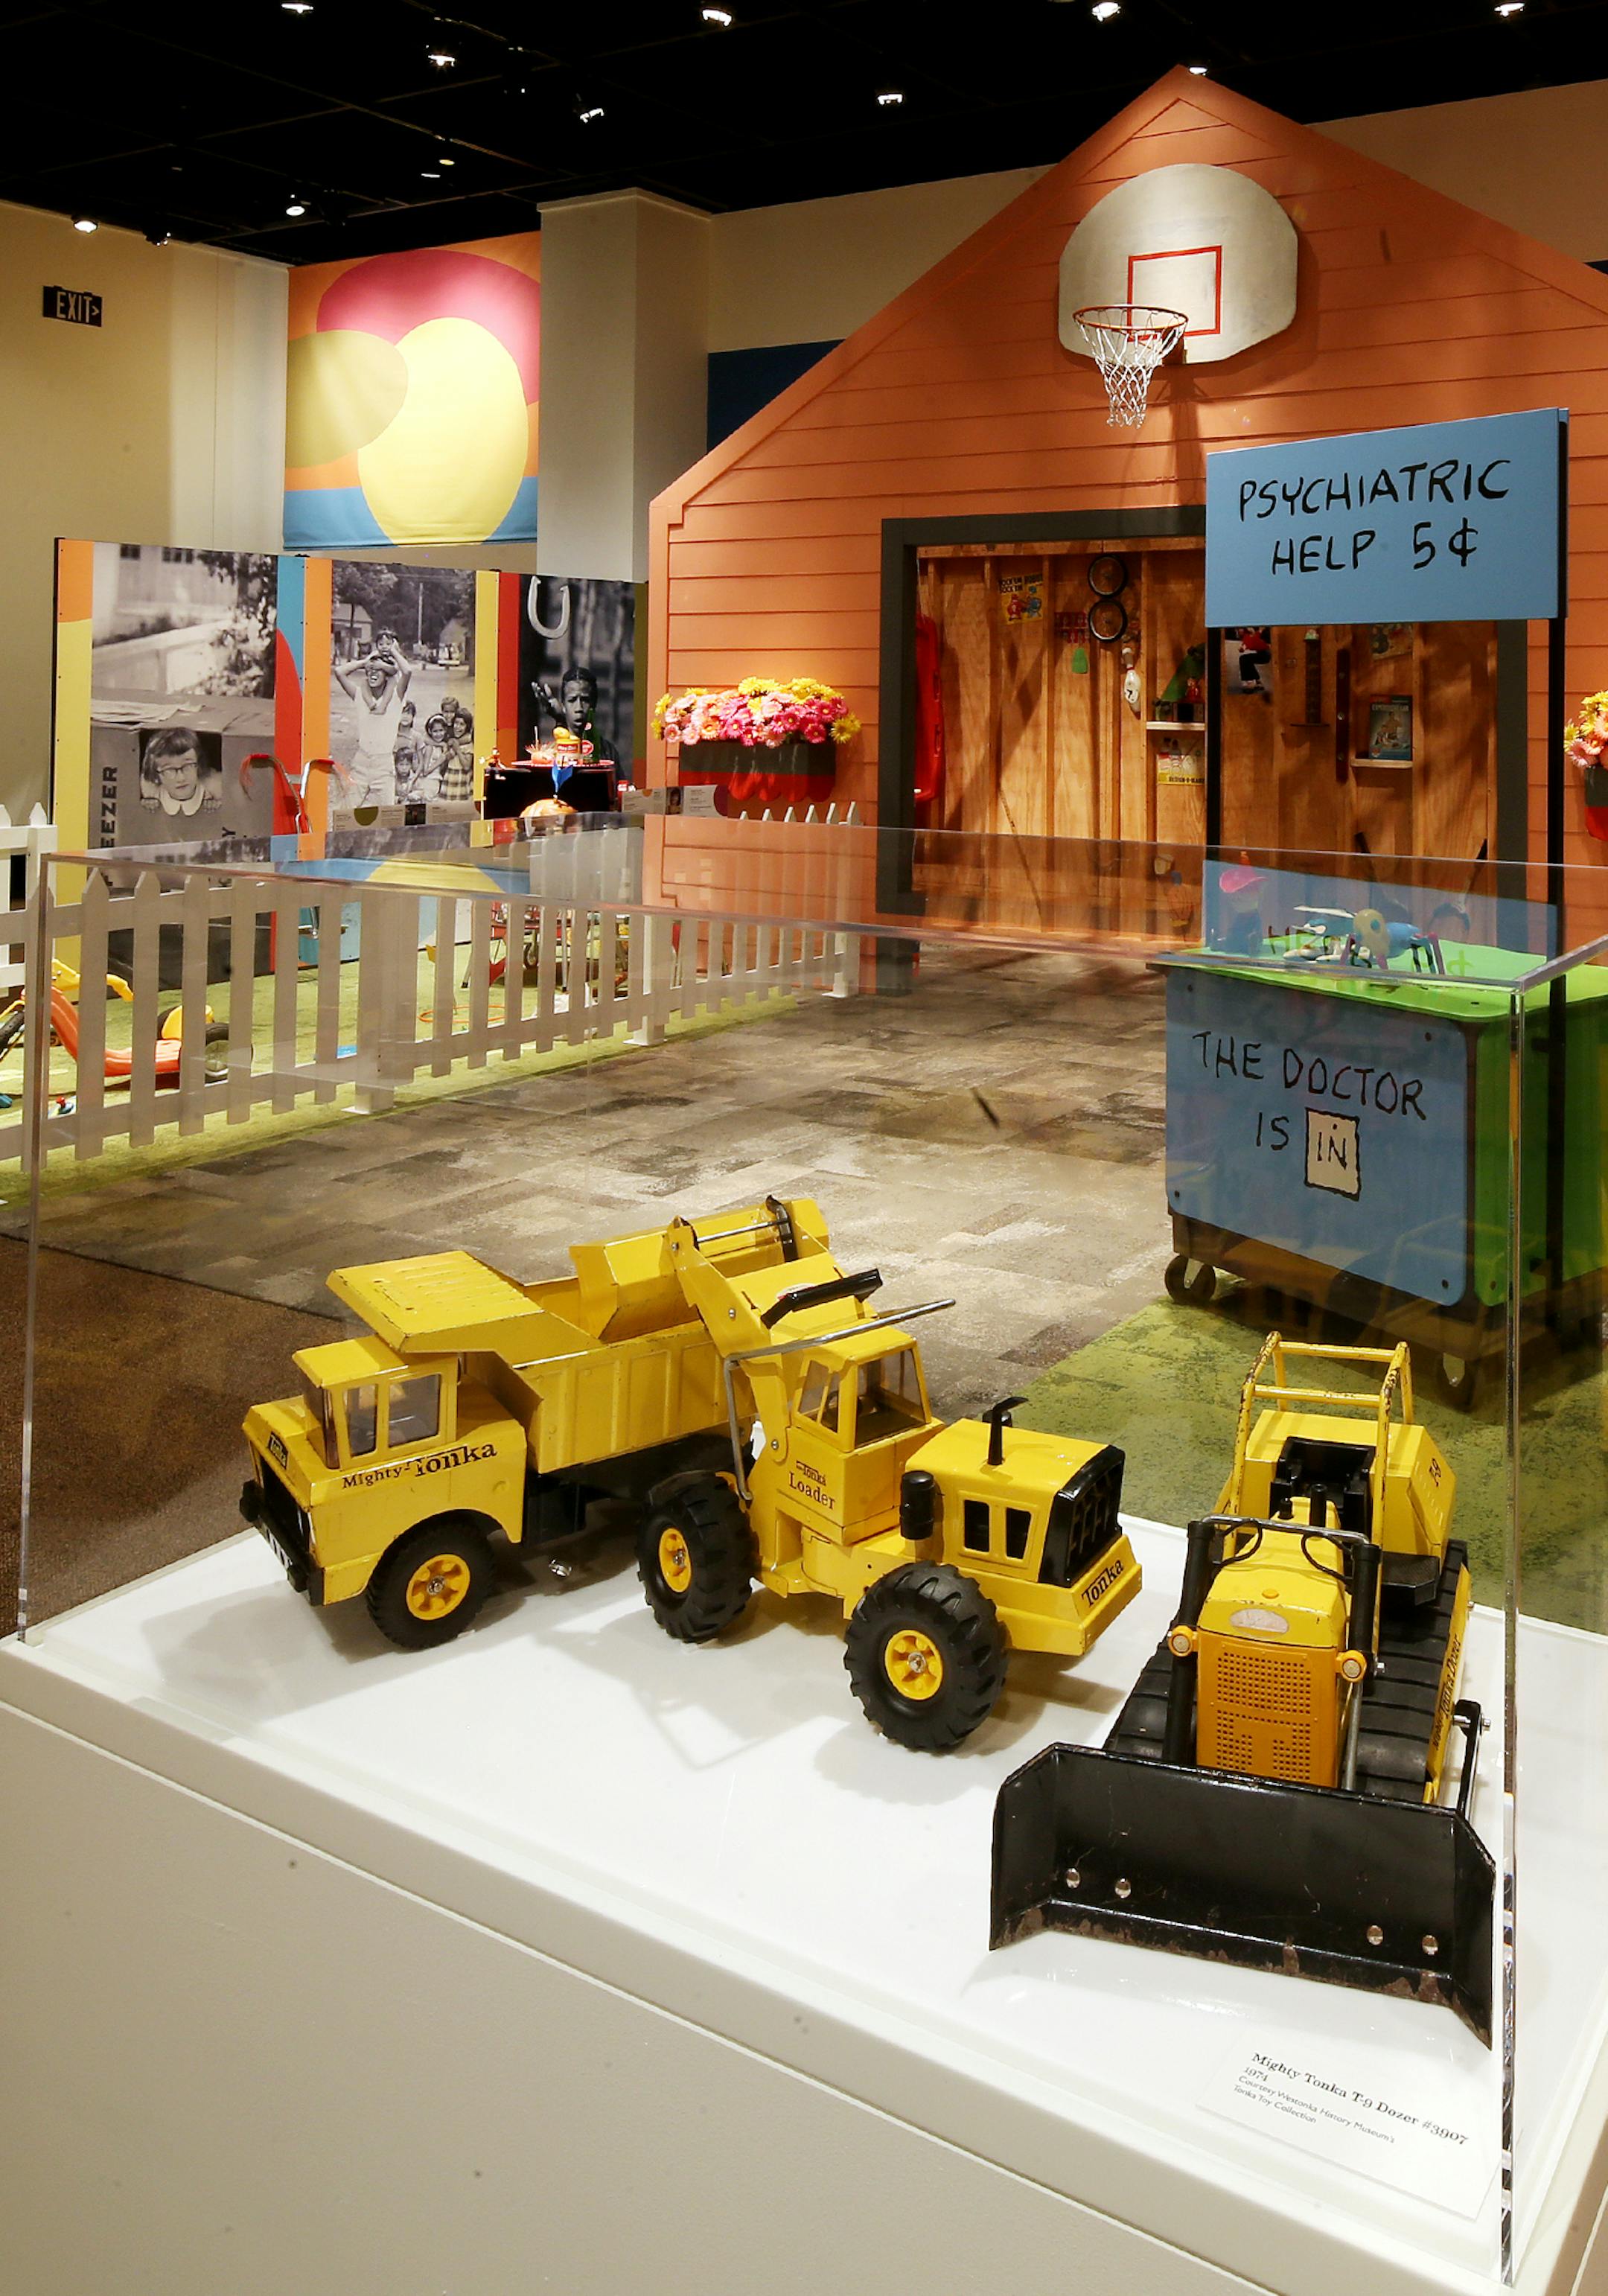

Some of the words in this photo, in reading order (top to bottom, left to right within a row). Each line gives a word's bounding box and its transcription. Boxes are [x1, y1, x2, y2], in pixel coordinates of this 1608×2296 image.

[57, 291, 93, 323] EXIT
[1239, 459, 1510, 522] PSYCHIATRIC
[1272, 529, 1376, 576] HELP
[100, 767, 118, 848] EEZER
[1193, 1030, 1264, 1080] THE
[1283, 1047, 1427, 1120] DOCTOR
[1256, 1112, 1290, 1151] IS
[1315, 1131, 1347, 1170] IN
[789, 1470, 835, 1511] Loader
[1082, 1559, 1124, 1607] Tonka
[1245, 2066, 1269, 2082] 1974
[1251, 2053, 1301, 2079] Mighty
[1304, 2073, 1347, 2098] Tonka
[1351, 2091, 1374, 2108] T-9
[1376, 2101, 1419, 2125] Dozer
[1422, 2120, 1469, 2145] #3907
[1234, 2084, 1257, 2099] Tonka
[1258, 2093, 1273, 2107] Toy
[1274, 2101, 1317, 2124] Collection
[1238, 2075, 1276, 2096] Courtesy
[1277, 2091, 1318, 2113] Westonka
[1319, 2108, 1352, 2126] History
[1353, 2121, 1395, 2143] Museum's
